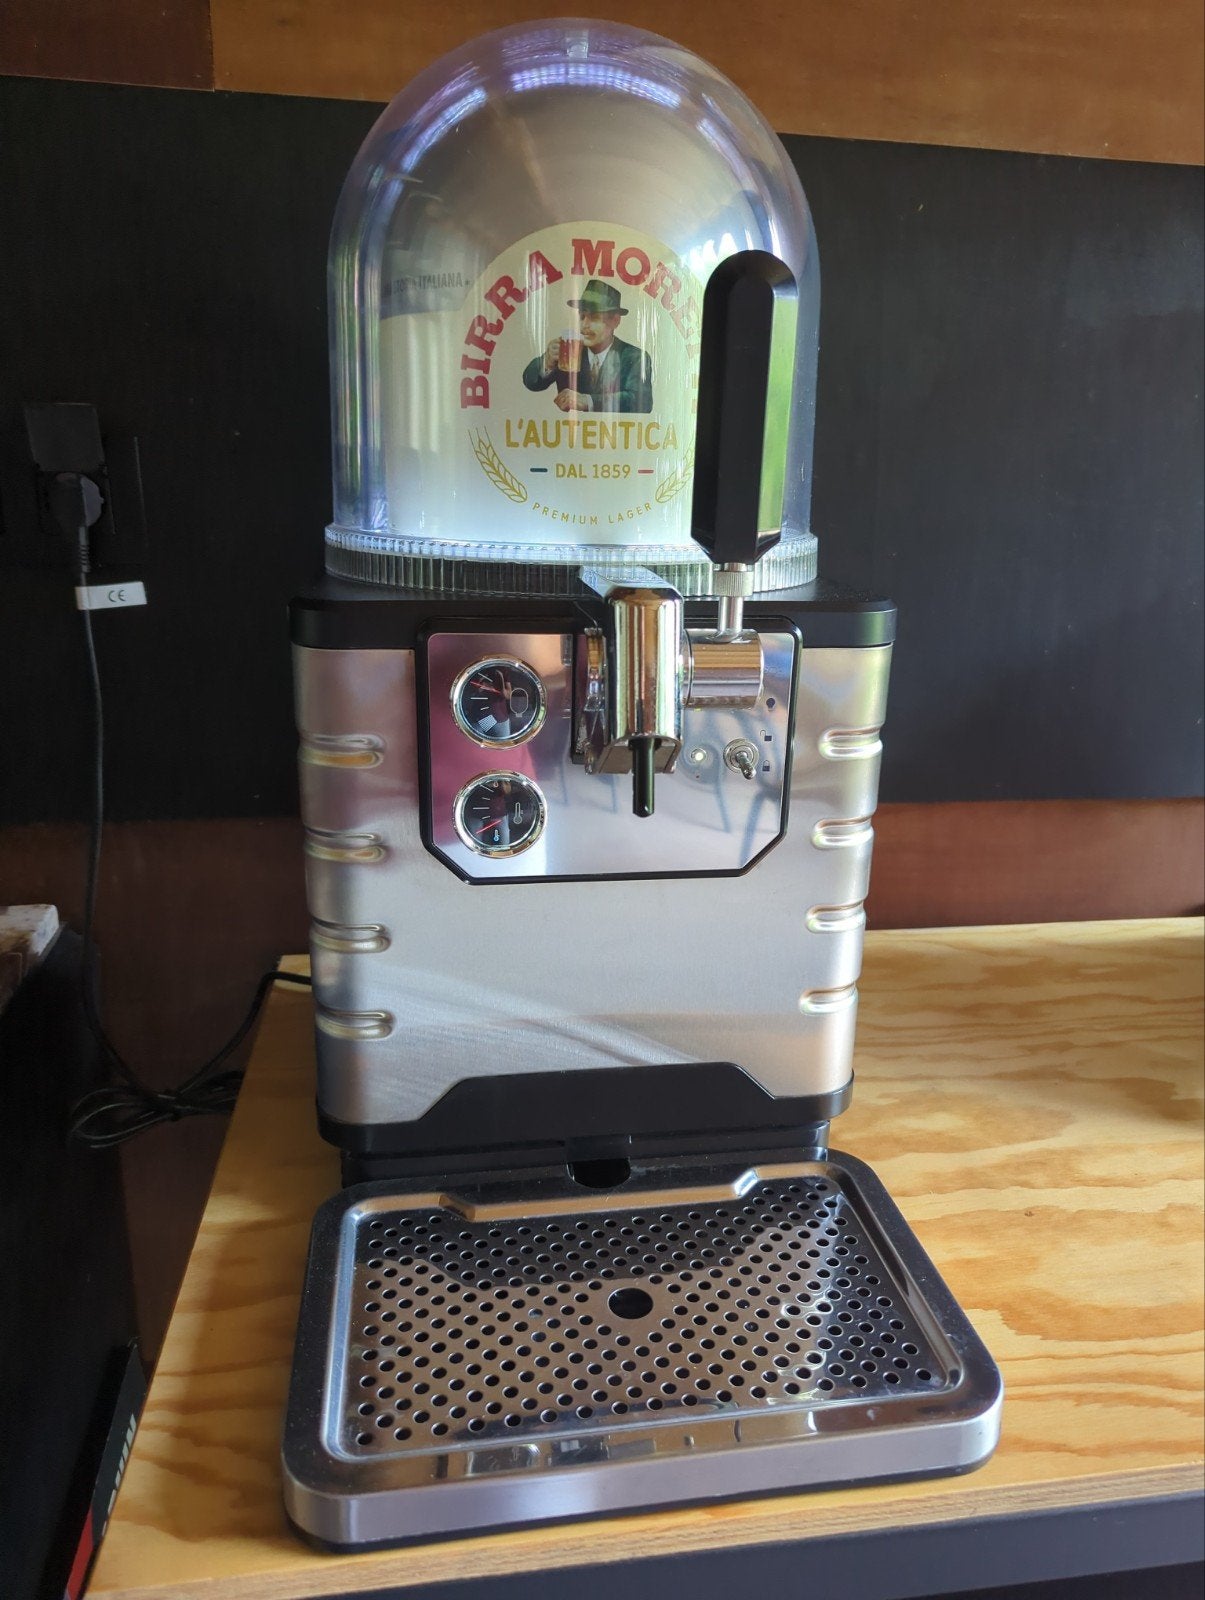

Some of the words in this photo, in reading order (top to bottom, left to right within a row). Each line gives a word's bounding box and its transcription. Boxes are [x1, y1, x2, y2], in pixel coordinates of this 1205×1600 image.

[460, 250, 564, 410] BIRRA
[570, 238, 700, 414] MORE
[505, 418, 678, 450] L'AUTENTICA
[555, 463, 587, 479] DAL
[592, 463, 631, 479] 1859
[532, 502, 598, 525] PREMIUM
[608, 502, 652, 524] LAGER
